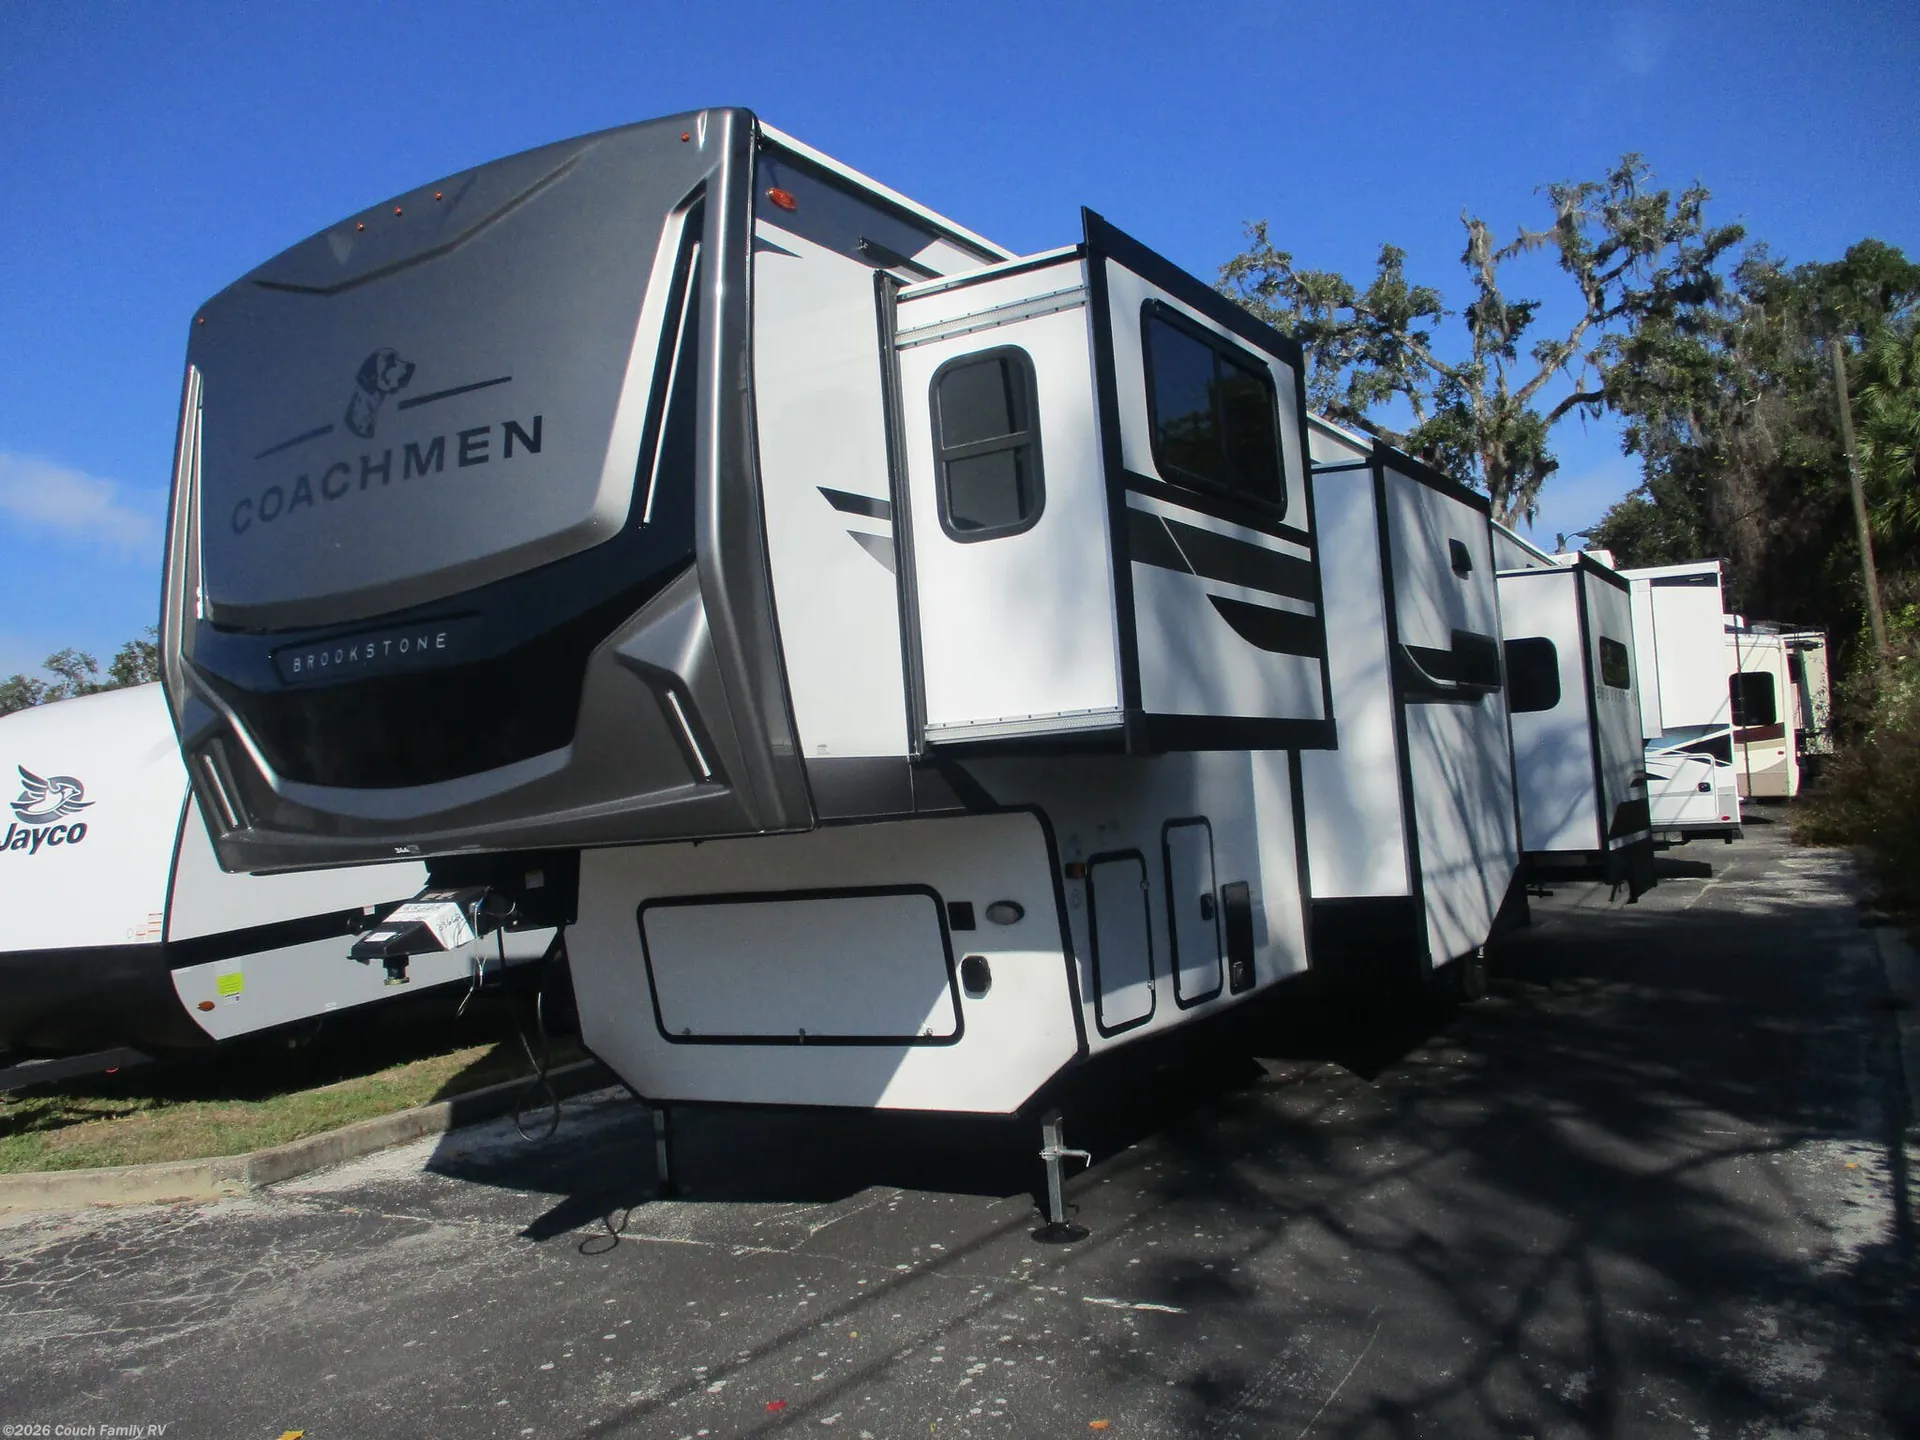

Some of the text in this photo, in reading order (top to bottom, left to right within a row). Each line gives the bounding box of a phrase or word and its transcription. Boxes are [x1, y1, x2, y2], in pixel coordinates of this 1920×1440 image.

[231, 415, 543, 535] COACHMEN
[293, 632, 447, 673] BROOKSTONE
[0, 822, 88, 855] Jayco
